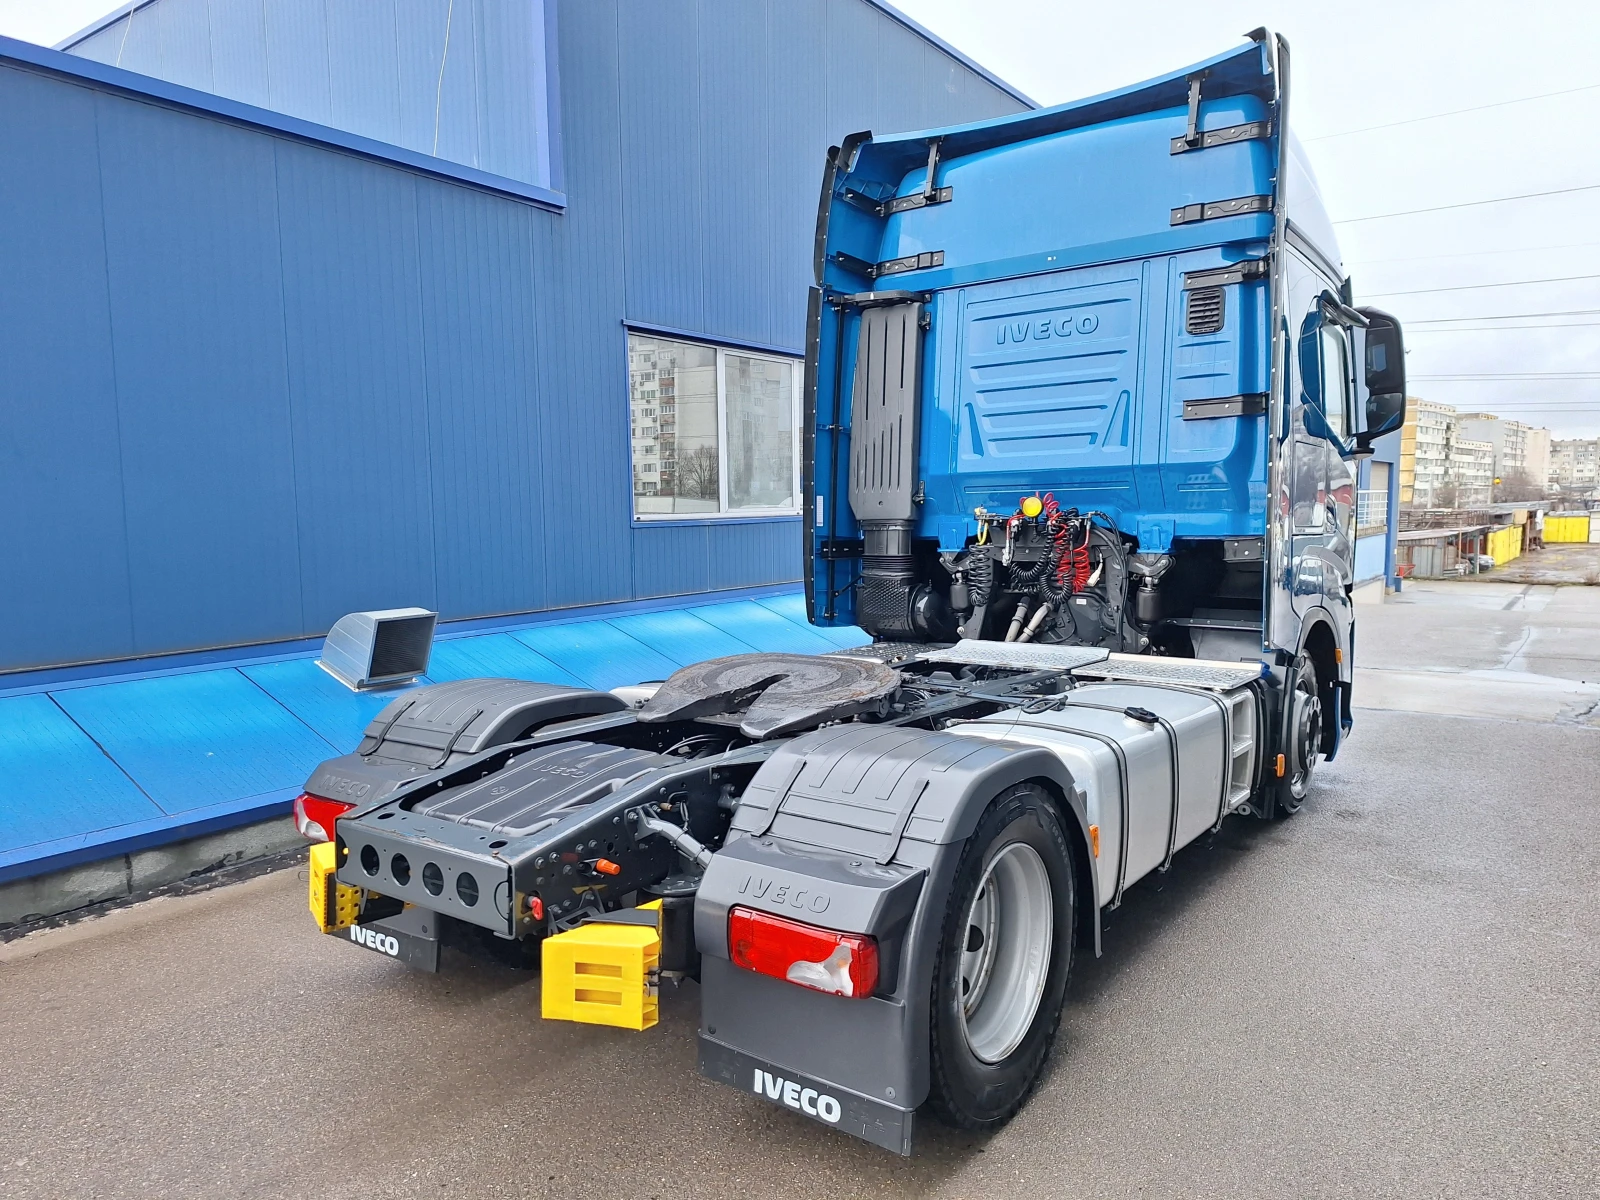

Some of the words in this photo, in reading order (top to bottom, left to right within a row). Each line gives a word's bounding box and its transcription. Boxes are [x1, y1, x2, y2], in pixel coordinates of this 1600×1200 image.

[996, 312, 1100, 345] IVECO
[319, 774, 371, 798] IVECO
[532, 763, 590, 779] IVECO
[737, 875, 832, 914] IVECO
[350, 924, 400, 957] IVECO
[753, 1068, 842, 1123] IVECO
